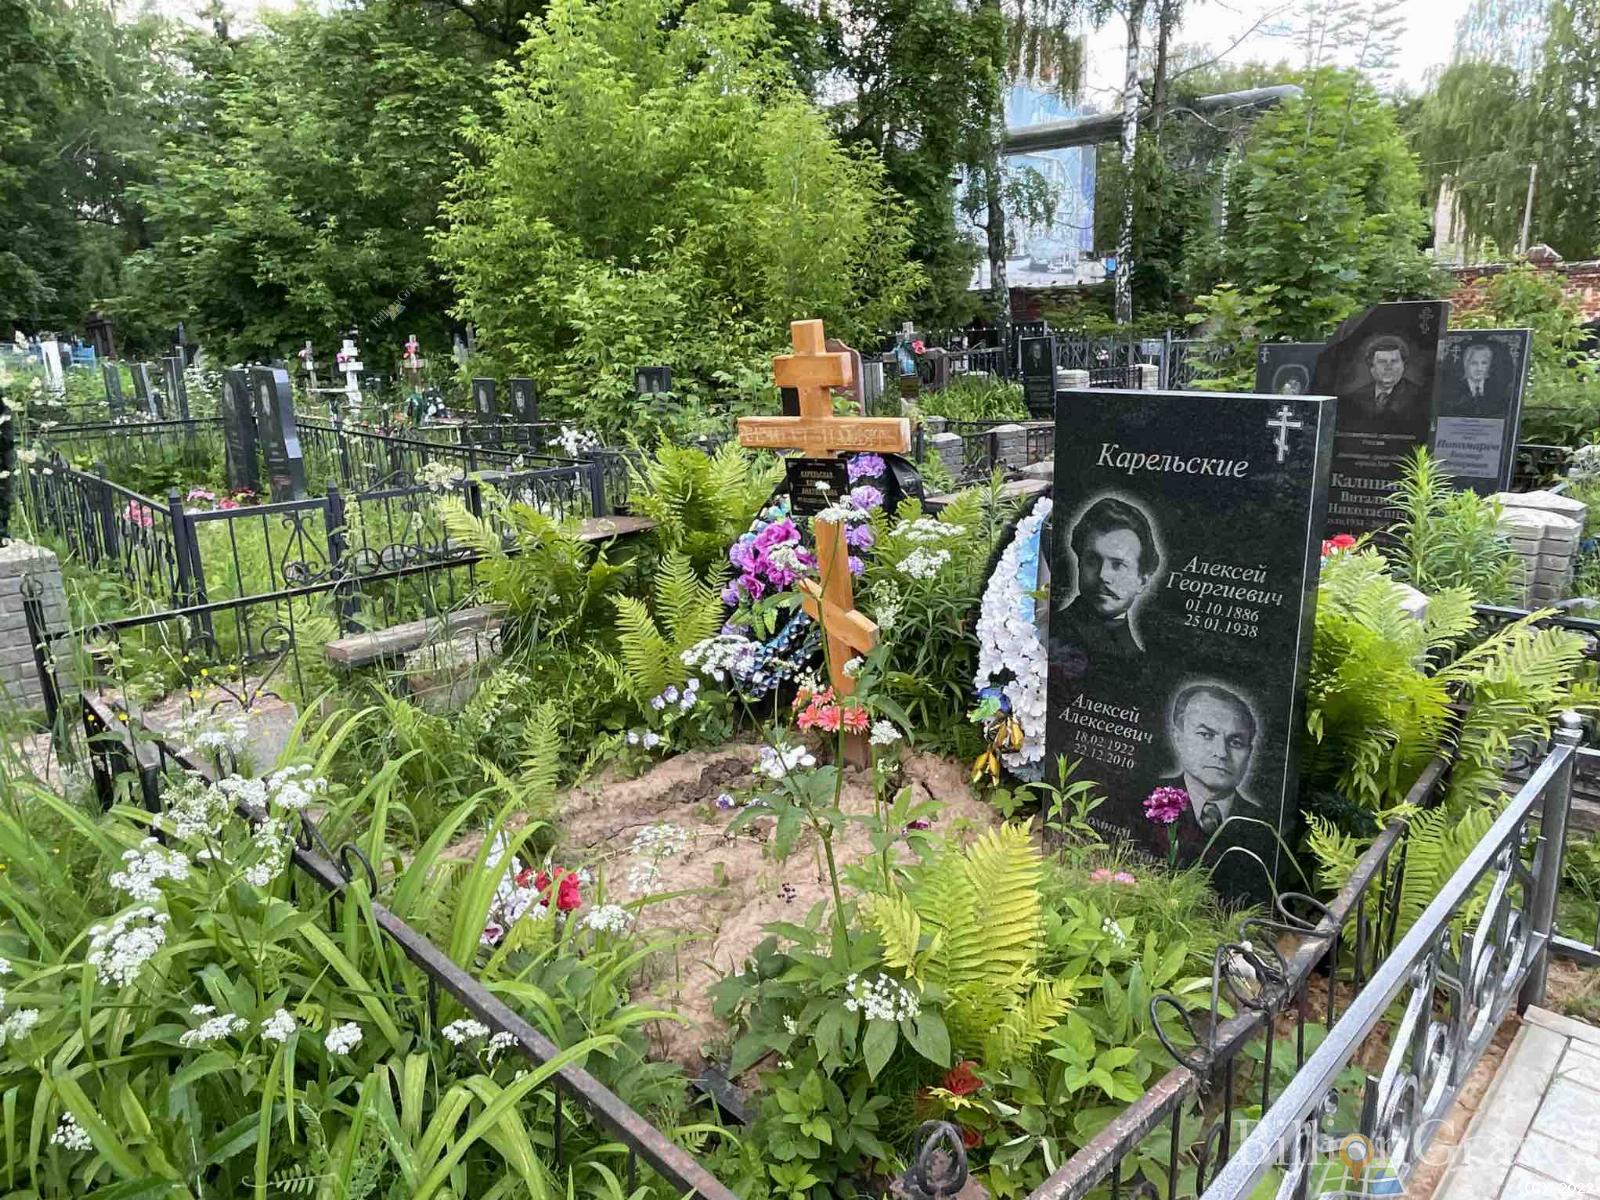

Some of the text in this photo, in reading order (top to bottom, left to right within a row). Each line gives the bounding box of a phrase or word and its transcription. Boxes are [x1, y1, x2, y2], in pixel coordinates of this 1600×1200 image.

[1096, 443, 1249, 479] Карельские
[1182, 555, 1268, 584] Алексей
[1167, 572, 1283, 606] Георгиевич
[1184, 614, 1259, 638] 25.01.1938
[1185, 599, 1260, 623] 01.10.1886
[1072, 693, 1140, 724] Алексей
[1059, 707, 1153, 744] Алексеевич
